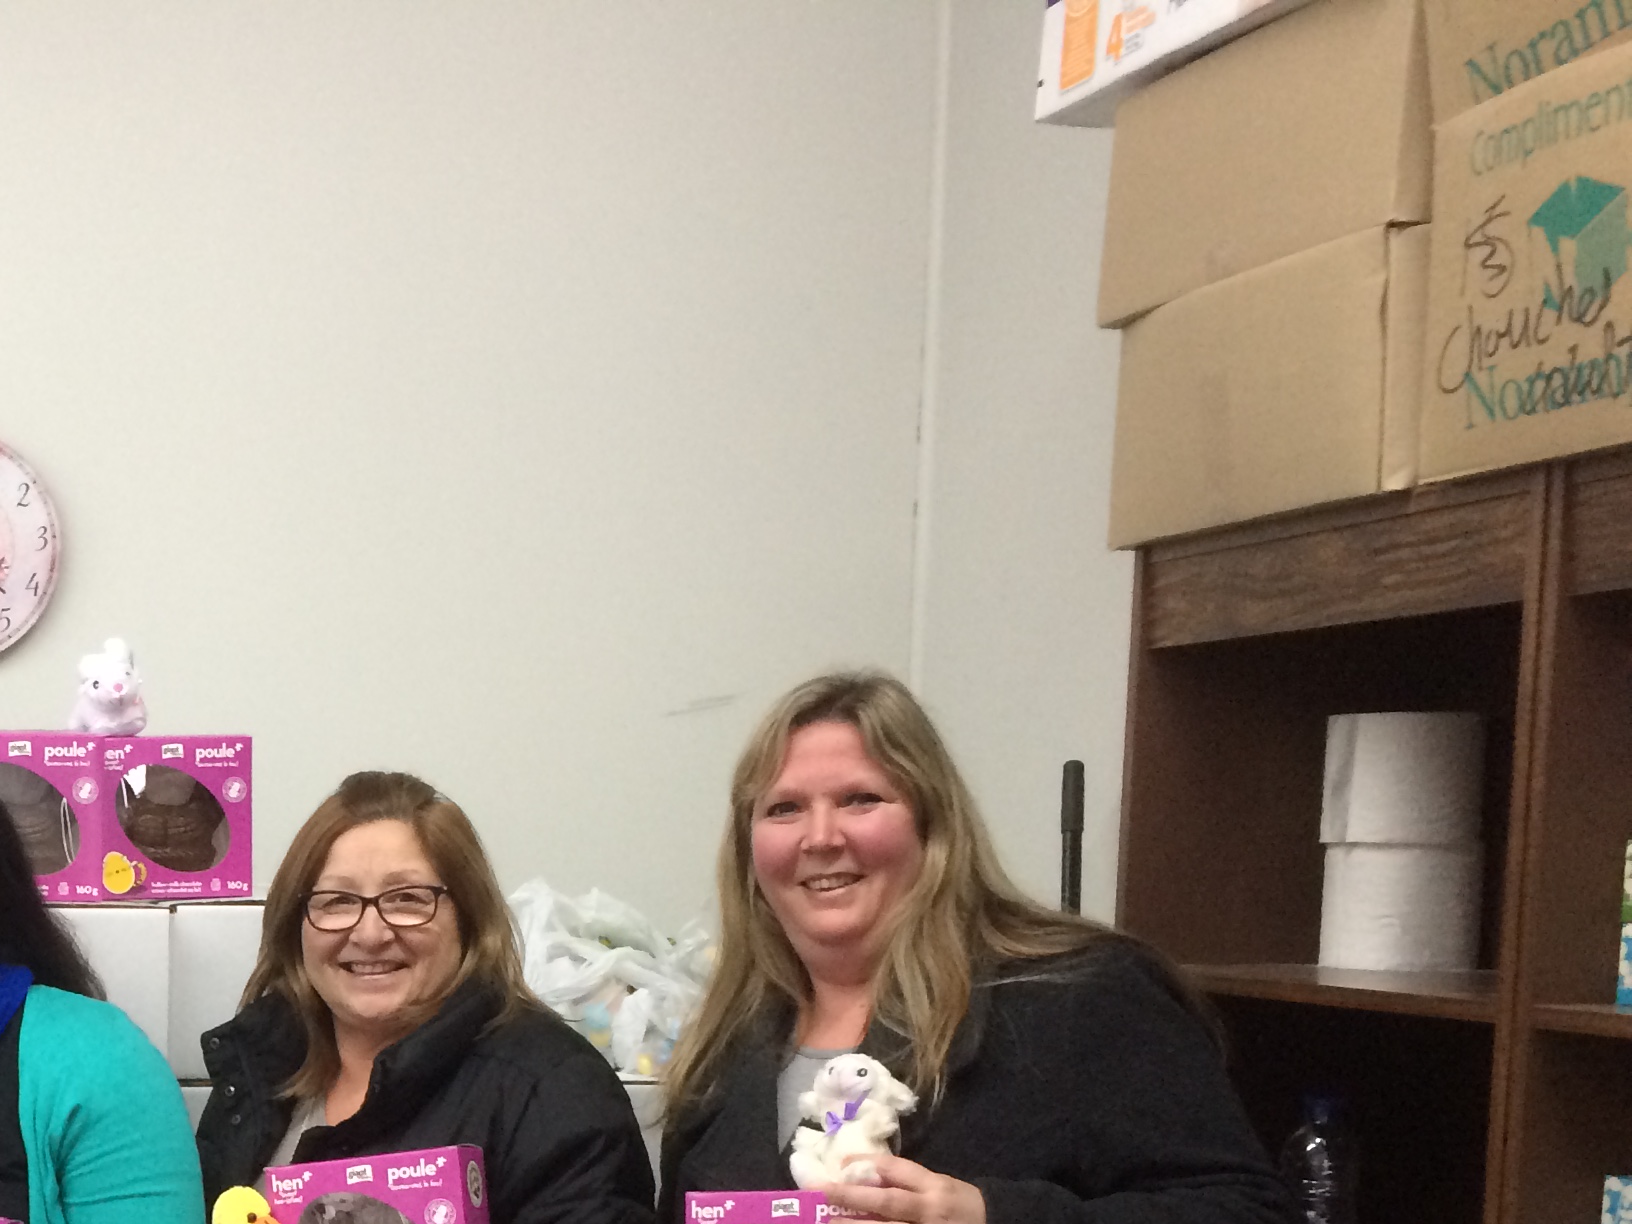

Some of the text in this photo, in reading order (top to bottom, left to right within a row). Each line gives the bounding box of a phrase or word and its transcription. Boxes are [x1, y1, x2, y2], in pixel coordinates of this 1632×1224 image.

[16, 482, 31, 508] 2
[34, 525, 49, 552] 3
[24, 572, 40, 597] 4
